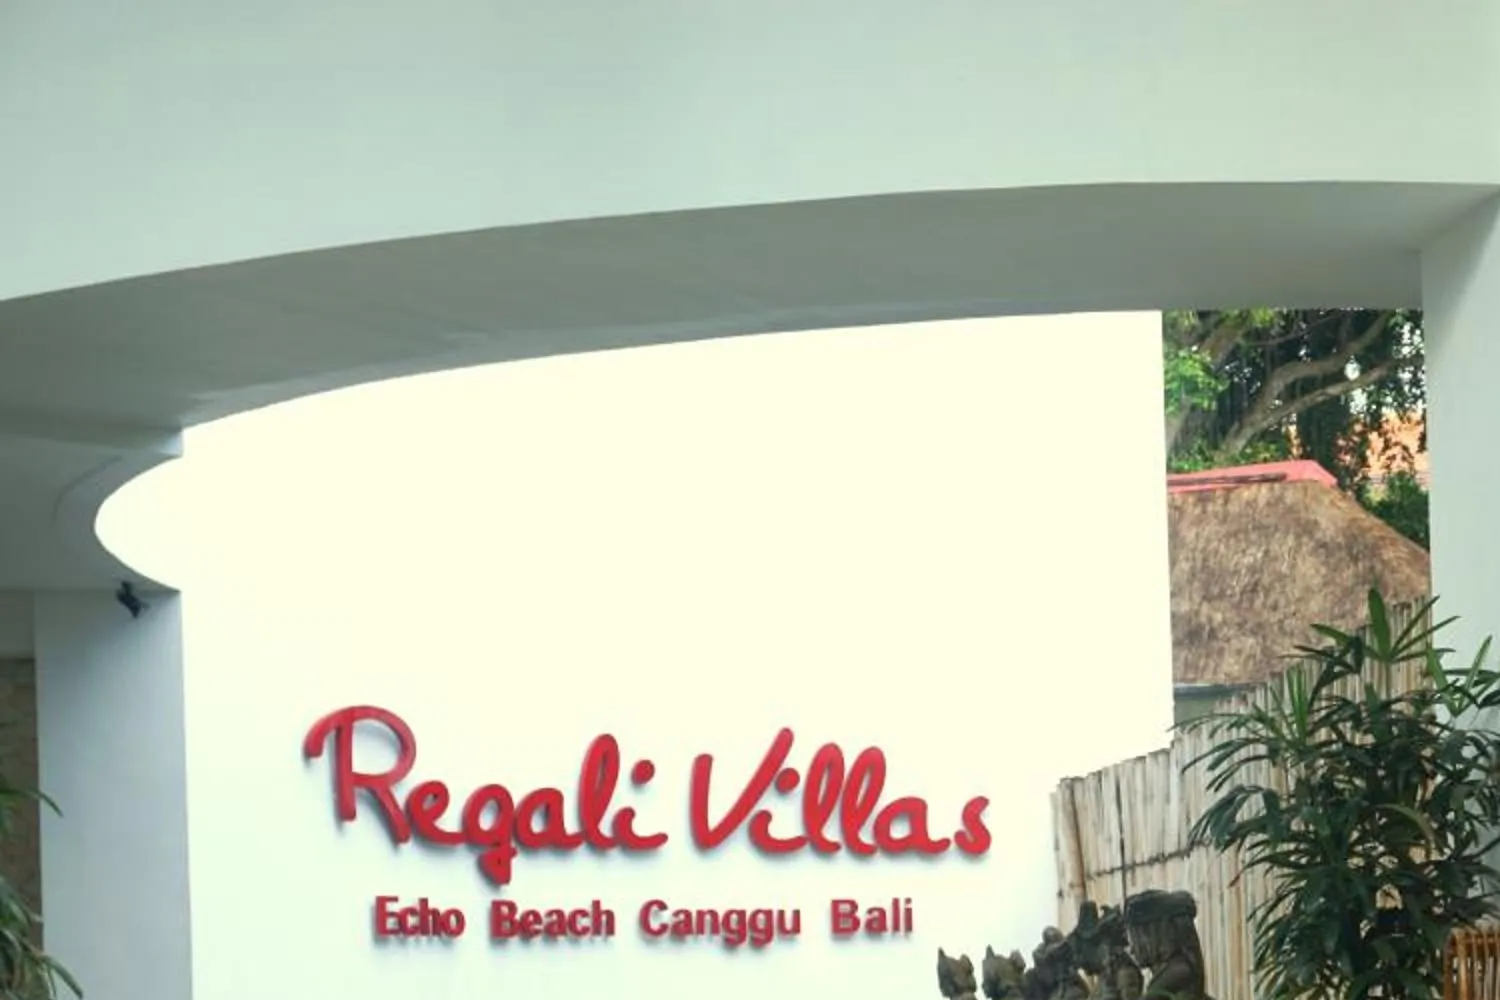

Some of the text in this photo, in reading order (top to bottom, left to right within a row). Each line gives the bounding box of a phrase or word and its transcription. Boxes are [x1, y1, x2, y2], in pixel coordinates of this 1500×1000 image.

[304, 705, 993, 885] Regali Villas
[375, 895, 912, 947] Echo Beach Canggu Bali
